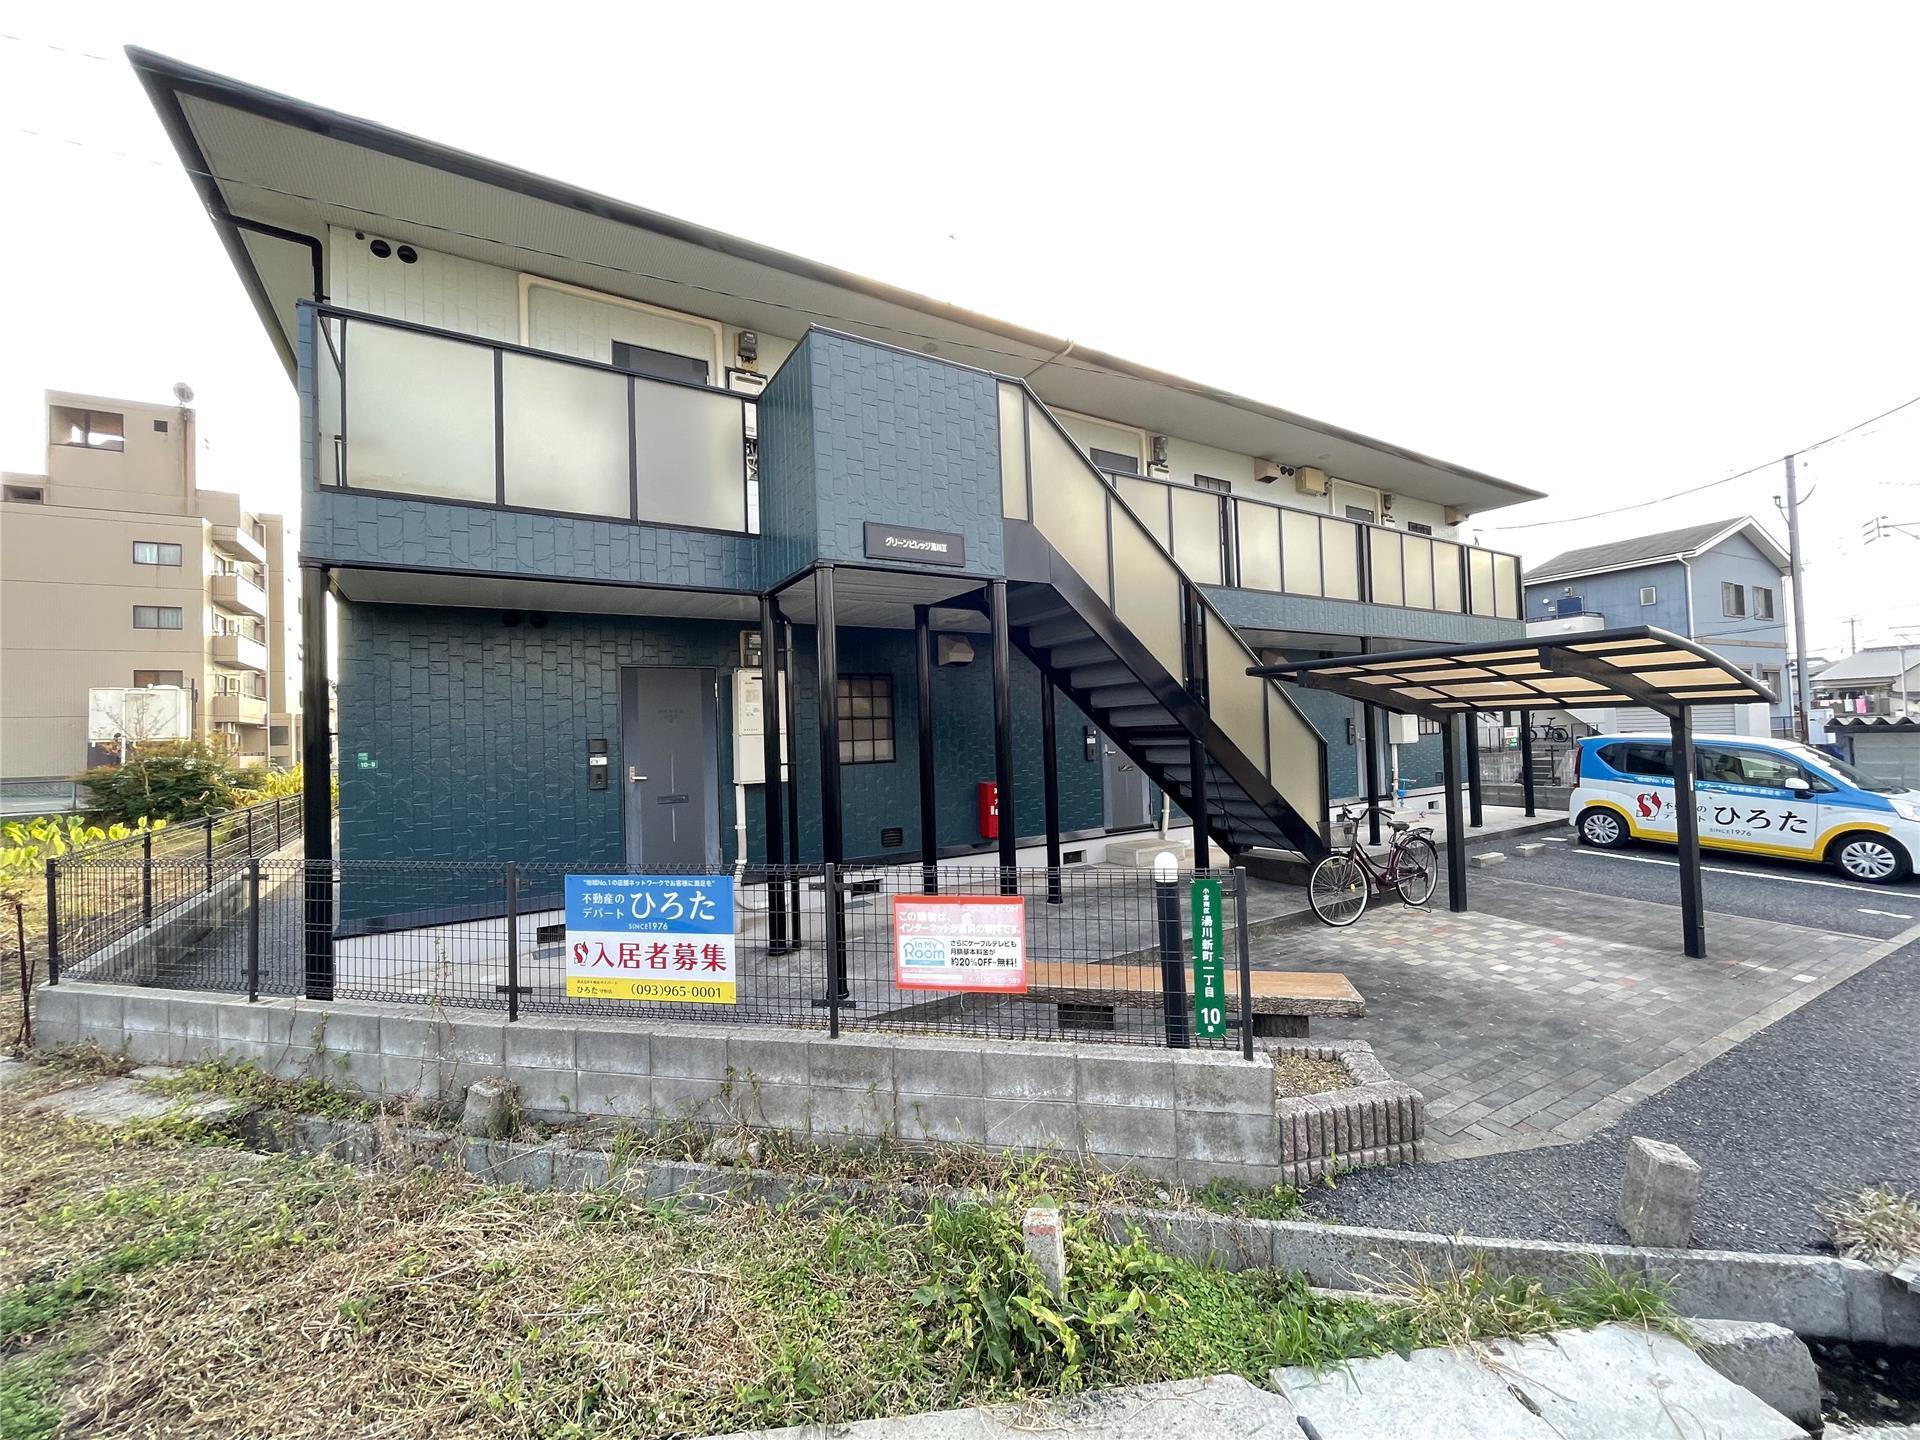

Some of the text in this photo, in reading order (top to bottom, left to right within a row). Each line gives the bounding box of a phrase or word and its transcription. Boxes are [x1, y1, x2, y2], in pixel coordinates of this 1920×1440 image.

[1713, 804, 1810, 834] ひろた
[581, 892, 625, 905] 不動産の
[630, 890, 716, 921] ひろた
[582, 907, 625, 920] デパート
[628, 922, 668, 931] SINCE1976
[903, 942, 945, 959] Room
[924, 941, 938, 950] My
[590, 941, 728, 973] 入居者募集
[1201, 915, 1214, 998] 湯川新町一丁目
[630, 983, 722, 999] (093)965-0001
[1201, 1007, 1221, 1025] 10
